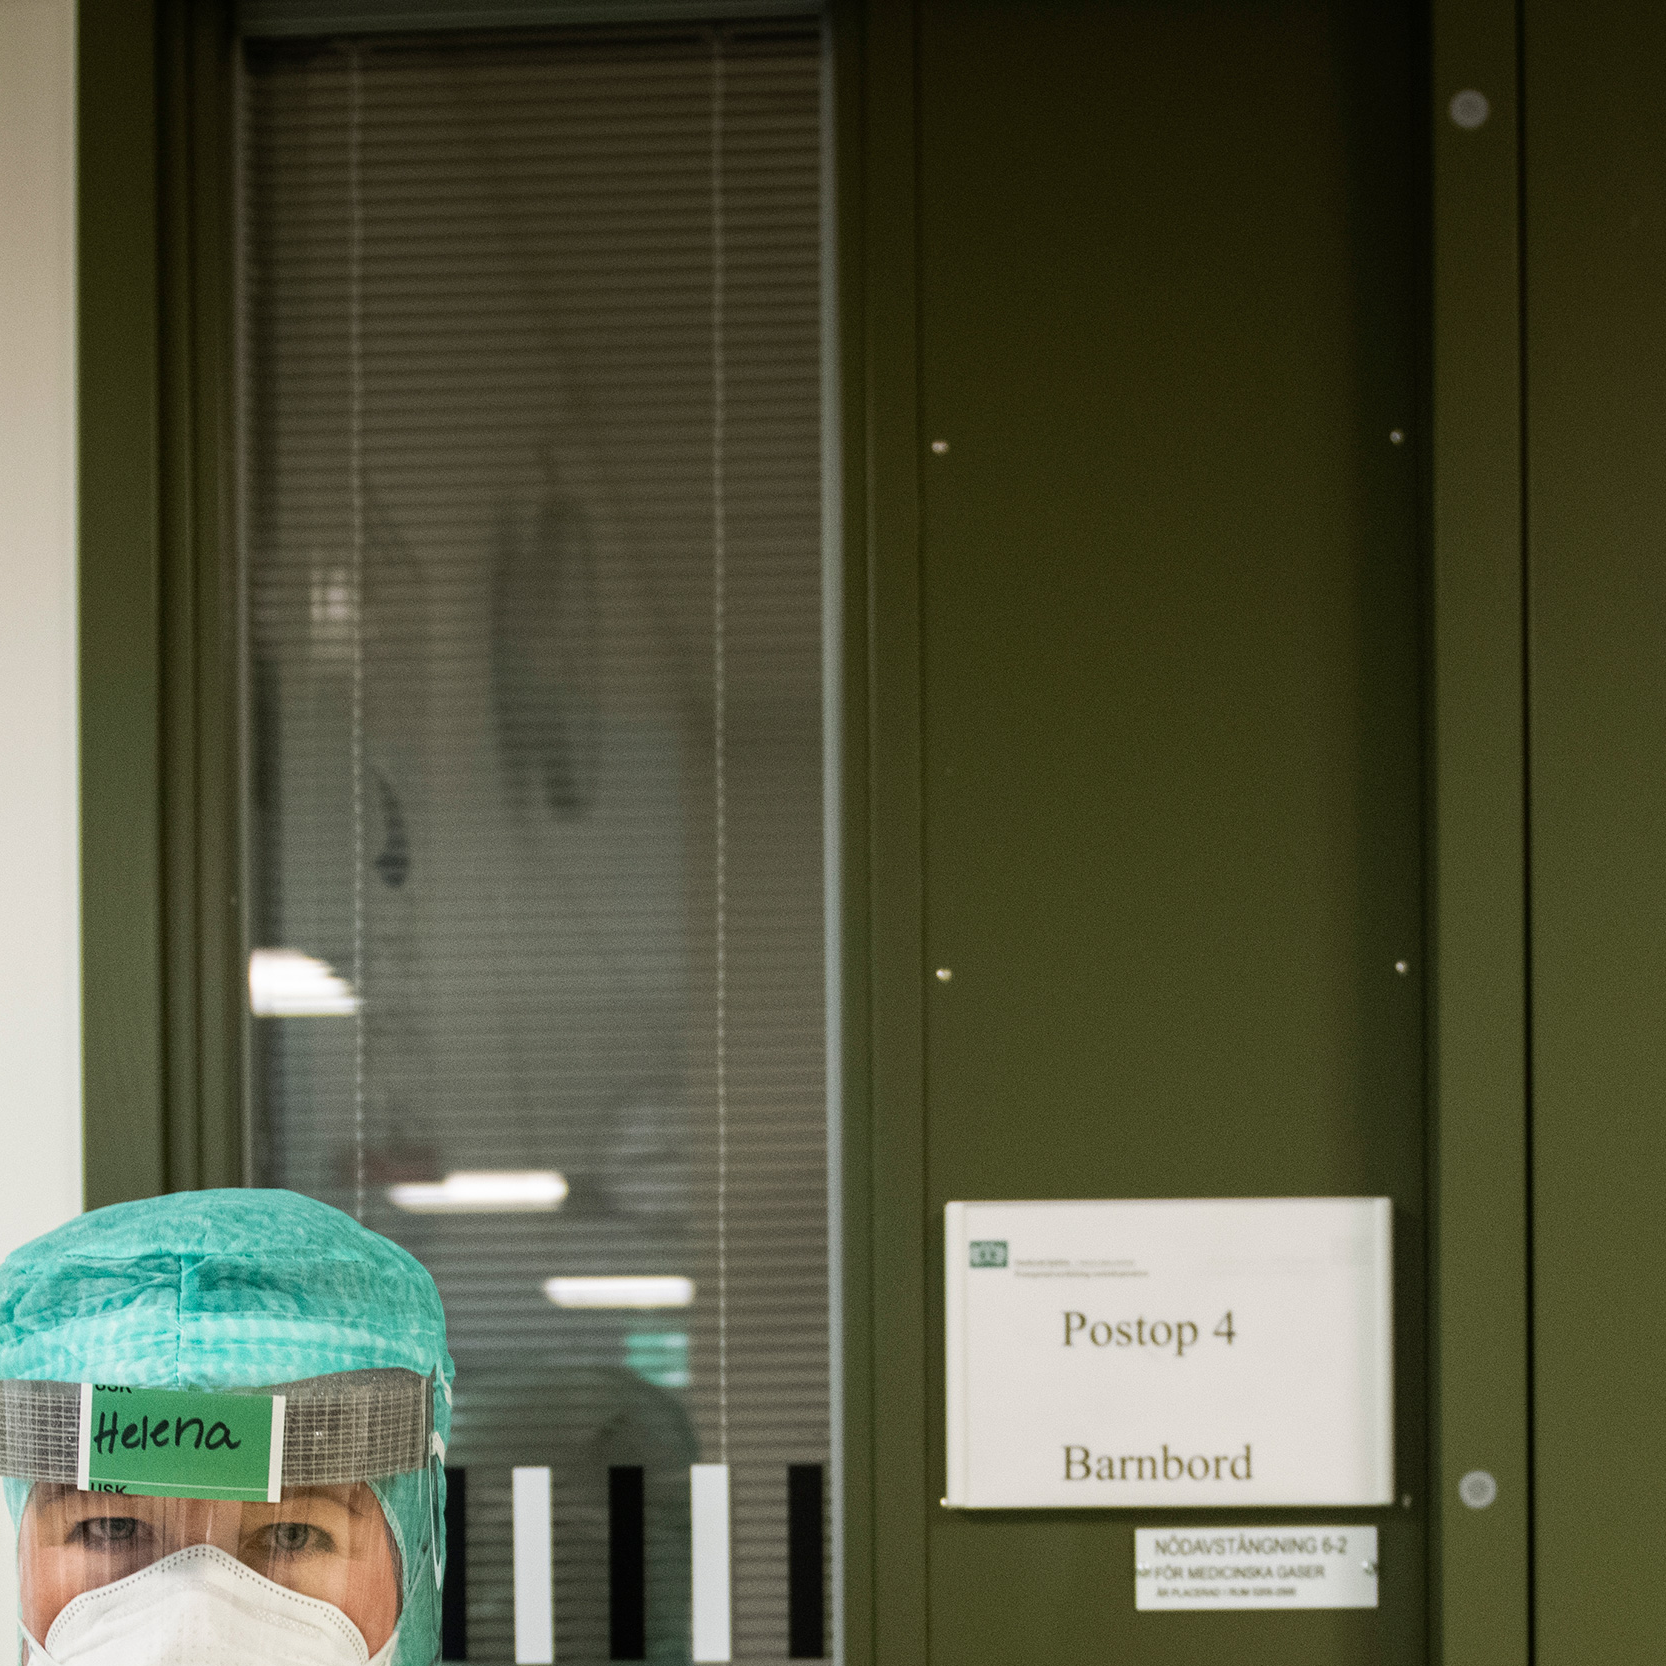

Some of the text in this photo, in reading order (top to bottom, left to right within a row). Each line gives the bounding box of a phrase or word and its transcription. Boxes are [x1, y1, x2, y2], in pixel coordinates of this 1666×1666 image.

[1063, 1309, 1236, 1357] Postop 4
[93, 1411, 242, 1455] Helena
[1063, 1443, 1253, 1481] Barnbord
